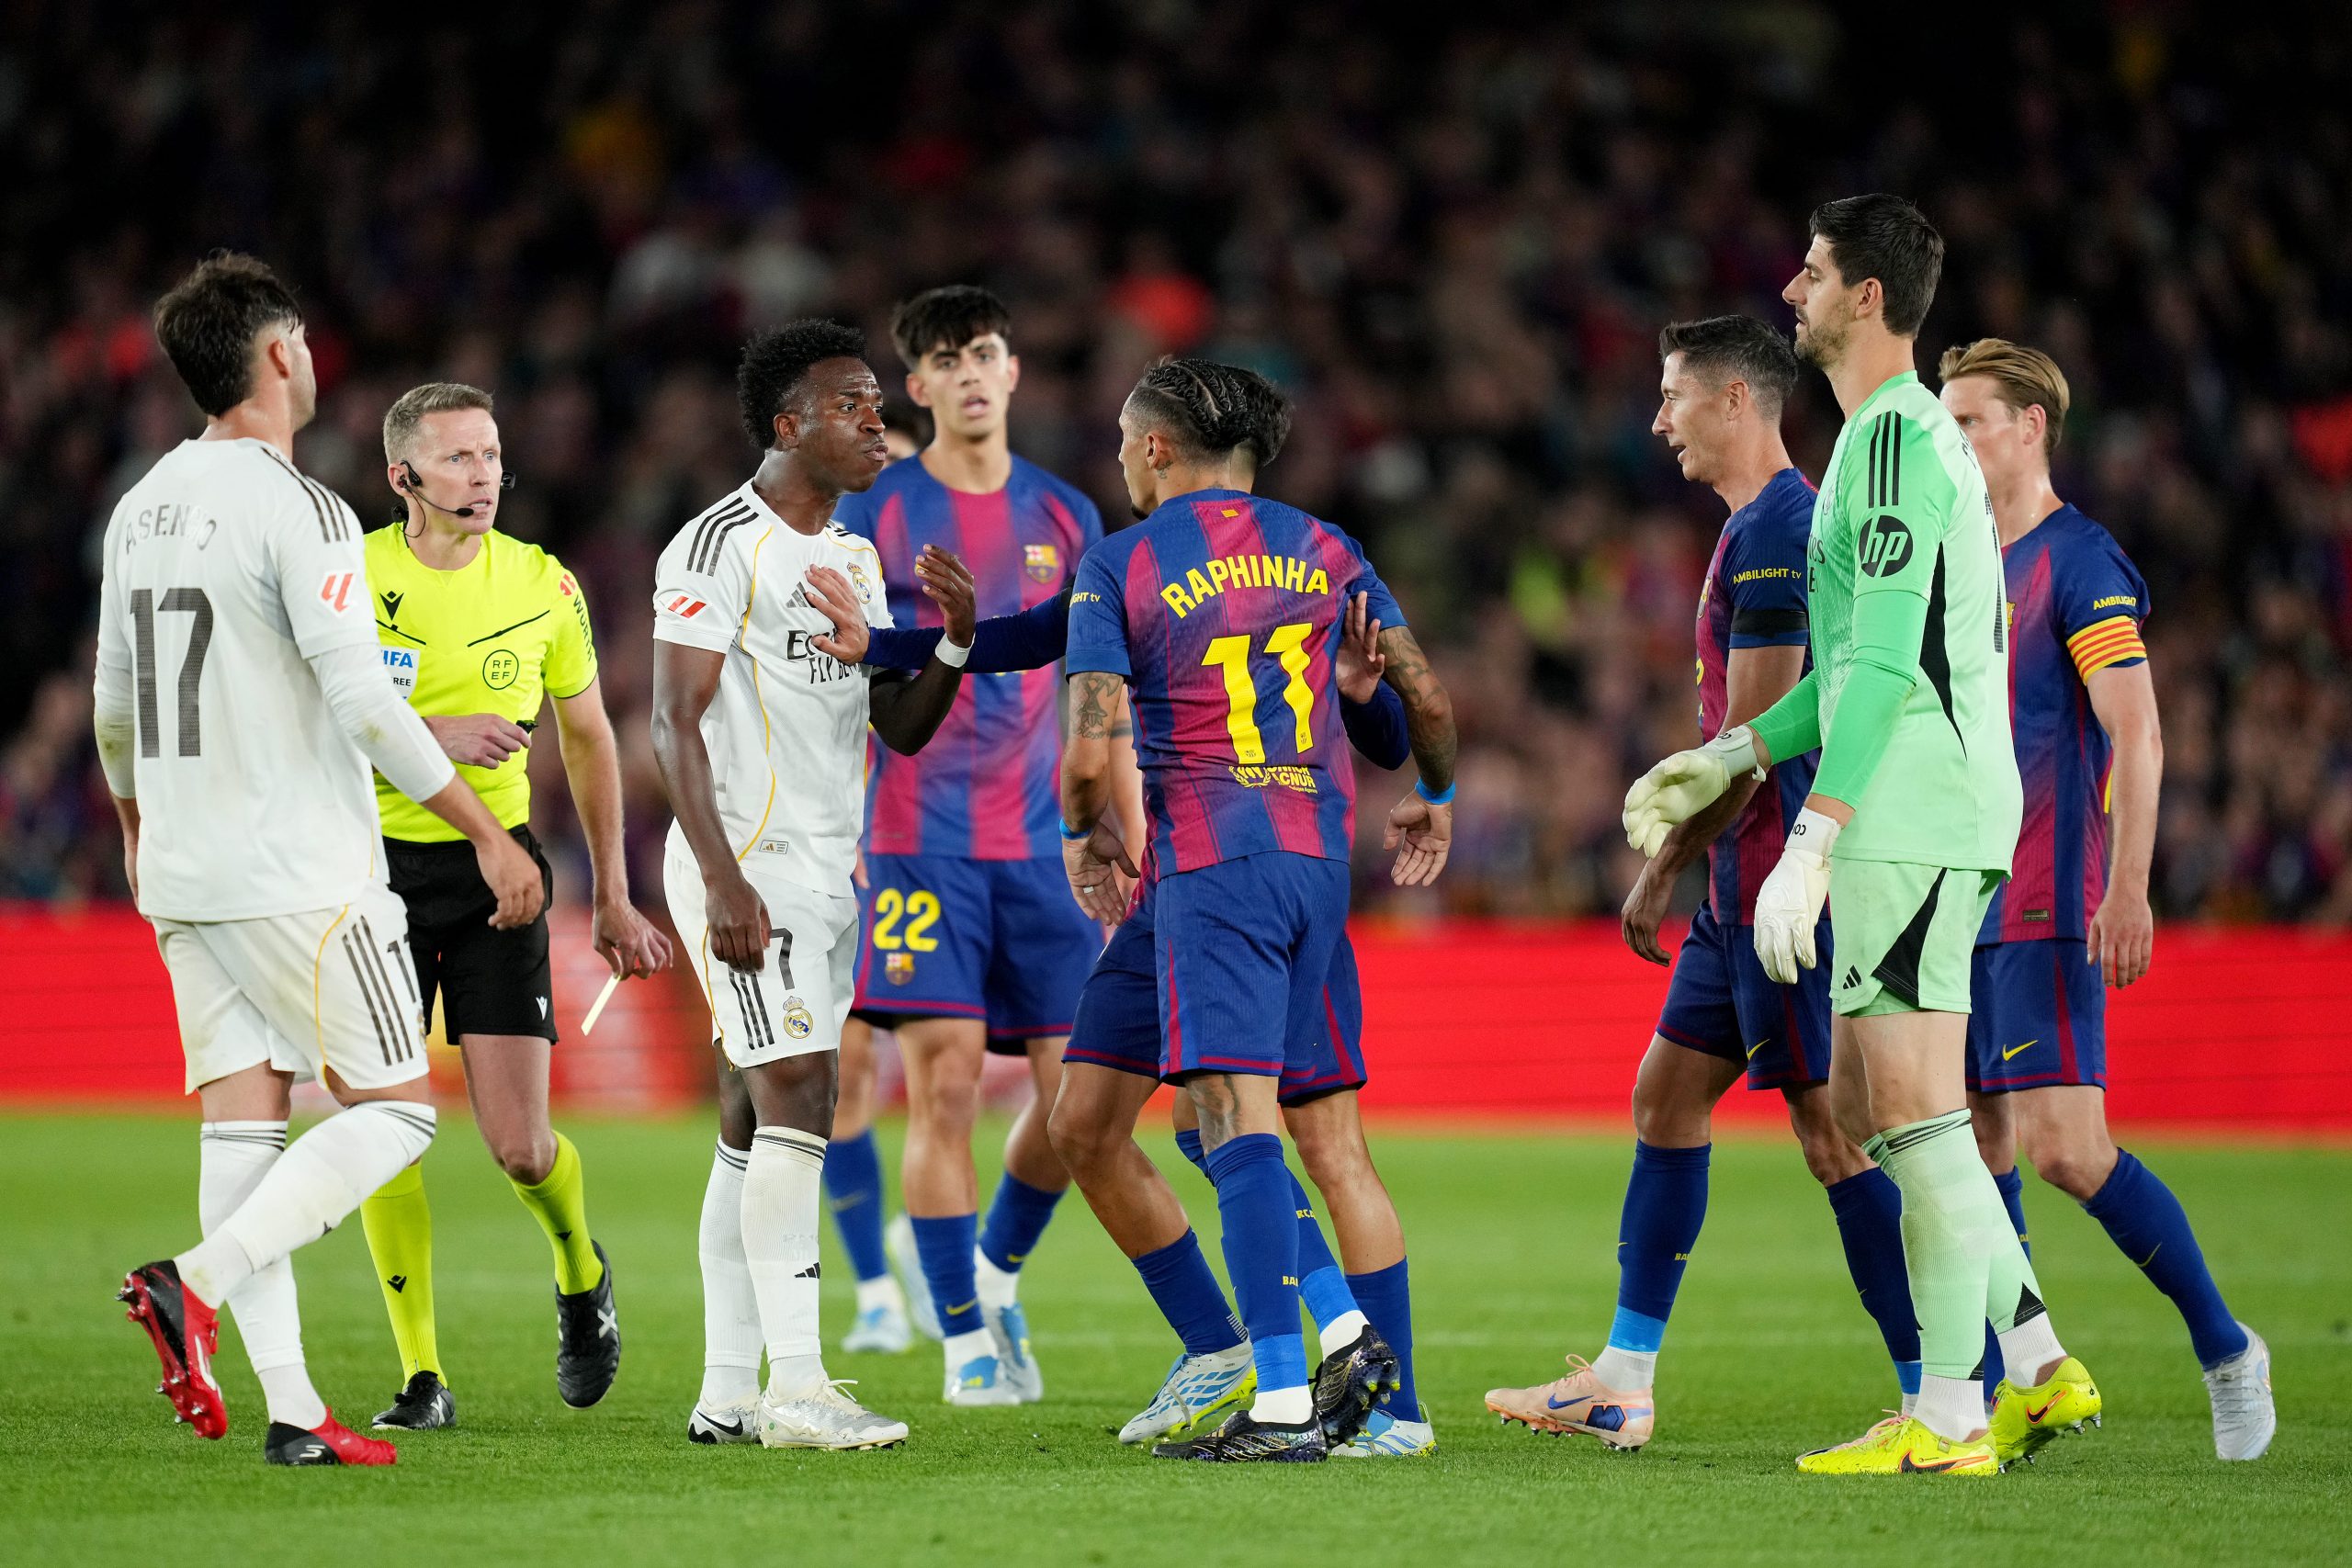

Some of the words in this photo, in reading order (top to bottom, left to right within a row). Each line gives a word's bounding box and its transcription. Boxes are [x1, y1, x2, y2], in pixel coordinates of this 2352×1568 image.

[126, 503, 217, 556] ASENO
[1861, 514, 1909, 578] hp
[1090, 592, 1101, 603] tv
[1159, 554, 1329, 619] RAPHINHA
[1733, 568, 1790, 585] AMBILIGHT
[1791, 570, 1802, 580] tv
[130, 586, 214, 759] 17
[382, 649, 413, 669] IFA
[392, 676, 412, 687] REE
[808, 656, 833, 685] FLY
[1201, 621, 1315, 765] 11
[872, 887, 942, 953] 22
[387, 933, 417, 1003] 1
[769, 927, 796, 991] 7
